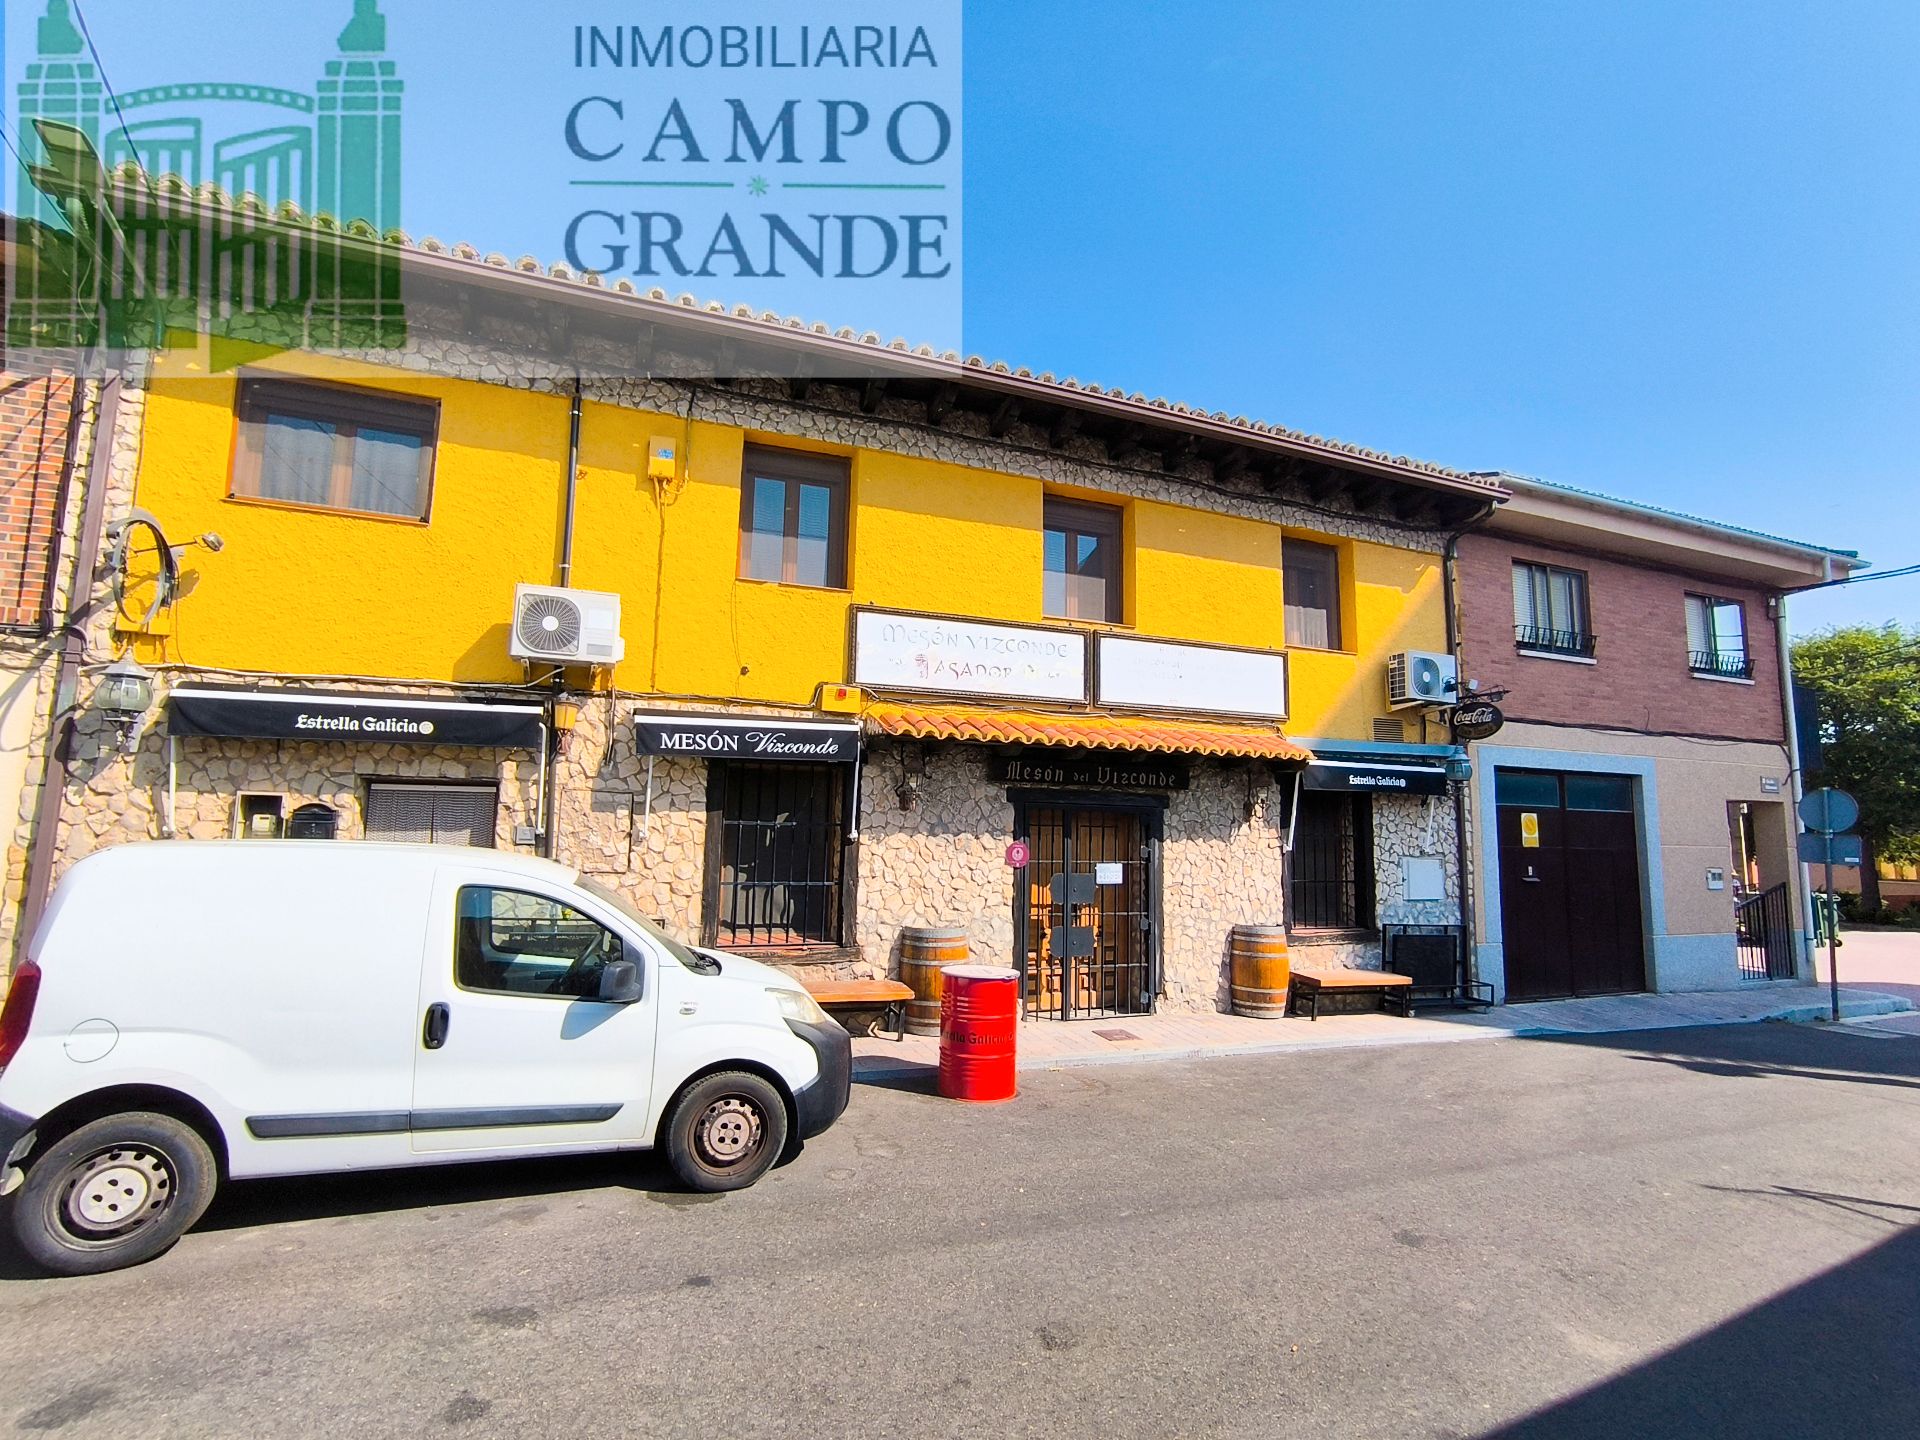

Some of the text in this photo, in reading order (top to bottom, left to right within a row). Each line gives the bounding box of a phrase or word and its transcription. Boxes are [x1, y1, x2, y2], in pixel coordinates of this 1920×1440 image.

[295, 714, 418, 733] Estrella Galicia
[1453, 707, 1494, 726] Coca-Cola
[659, 730, 839, 755] MESÓN Vizconde
[1005, 761, 1176, 786] Mesón del Vizconde
[1348, 774, 1400, 786] Estrella Galicia
